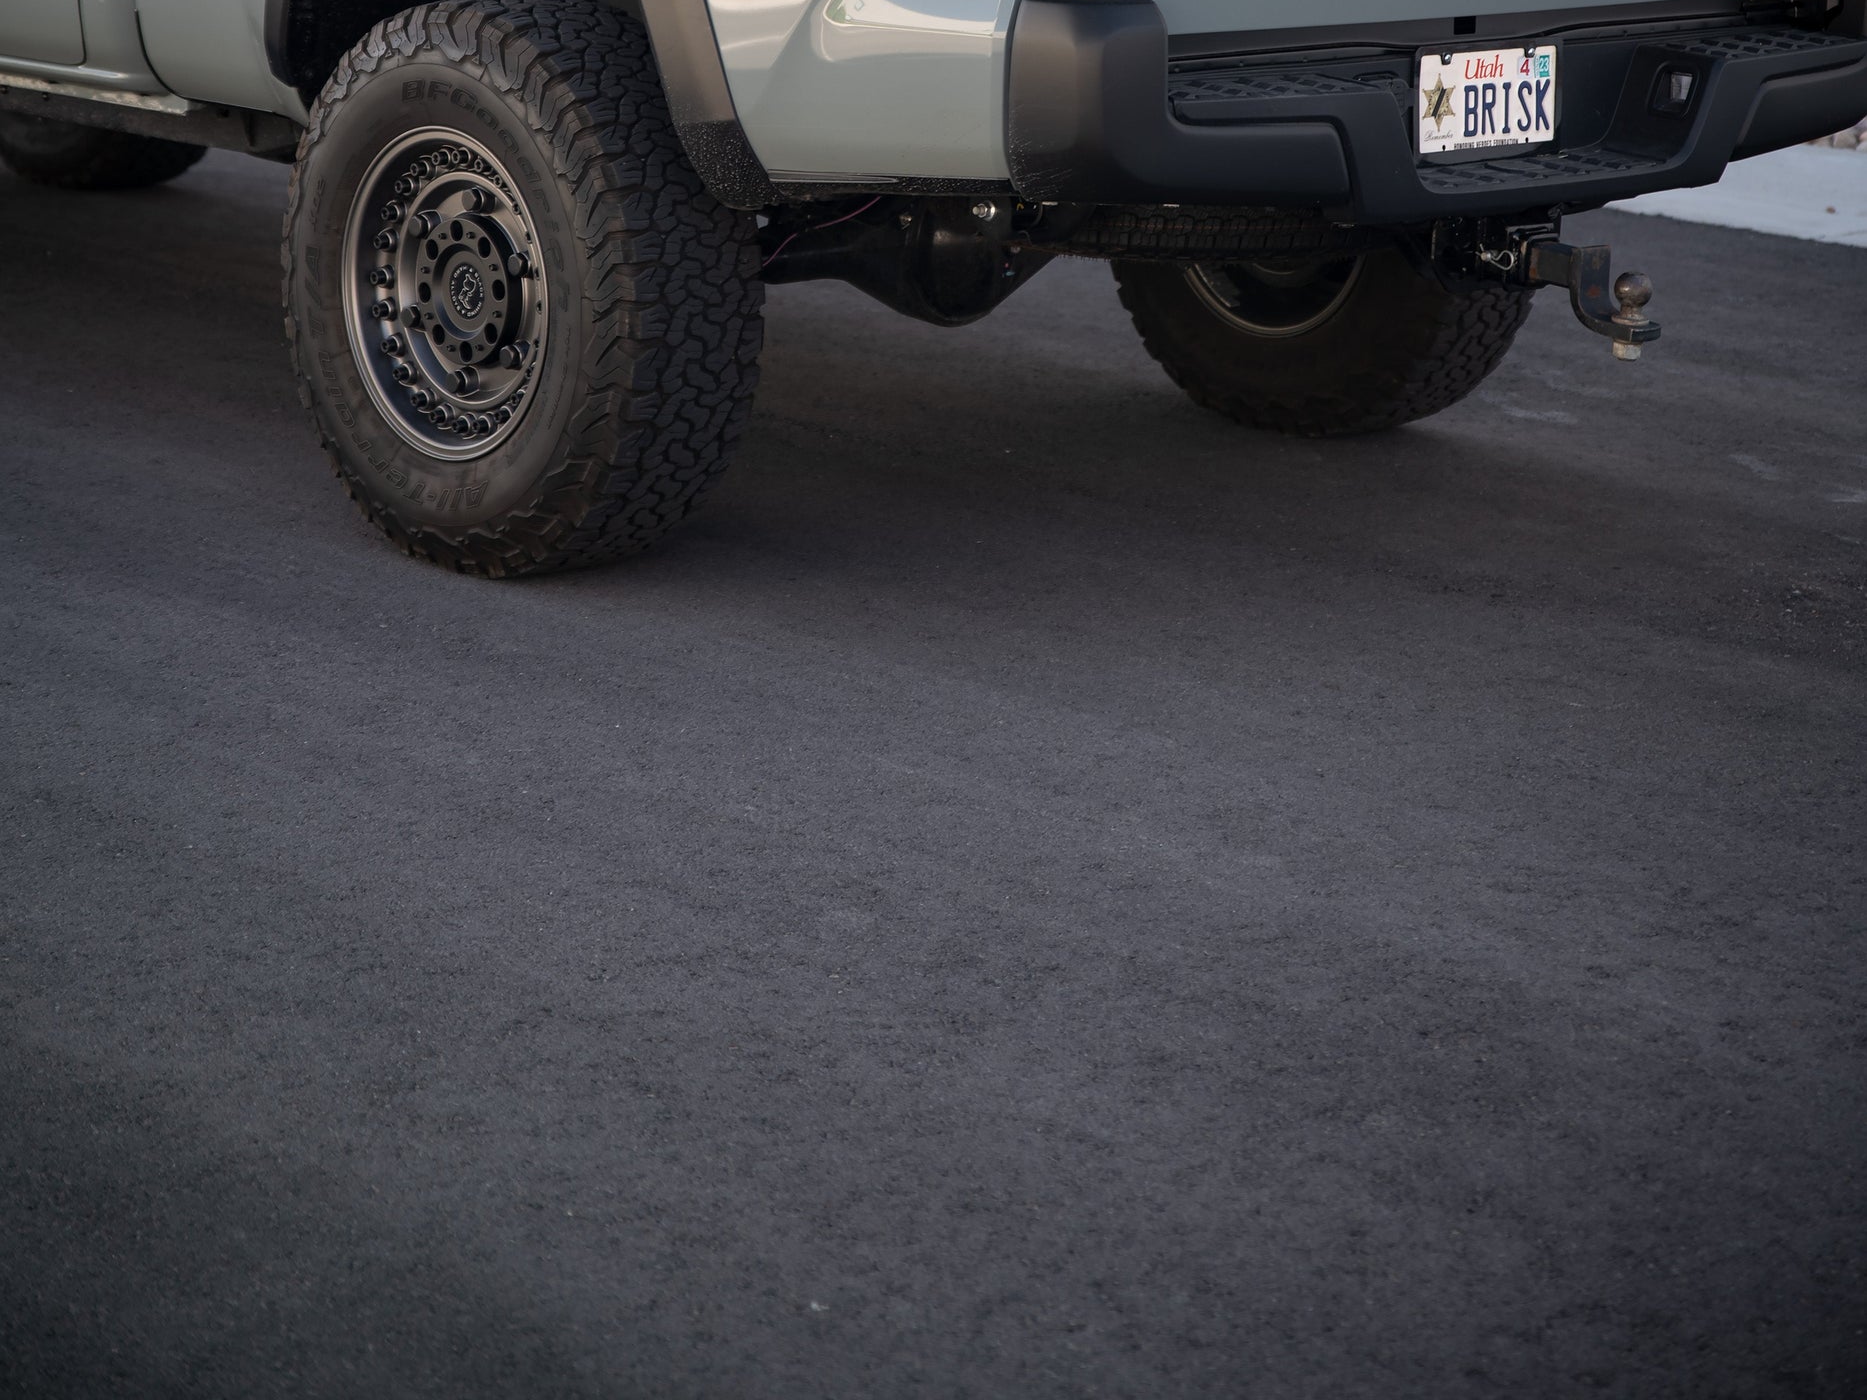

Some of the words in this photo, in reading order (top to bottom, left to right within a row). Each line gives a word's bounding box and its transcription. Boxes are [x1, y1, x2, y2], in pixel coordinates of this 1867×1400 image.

[1464, 54, 1504, 80] Utah
[1519, 58, 1530, 76] 4
[1463, 79, 1551, 137] BRISK
